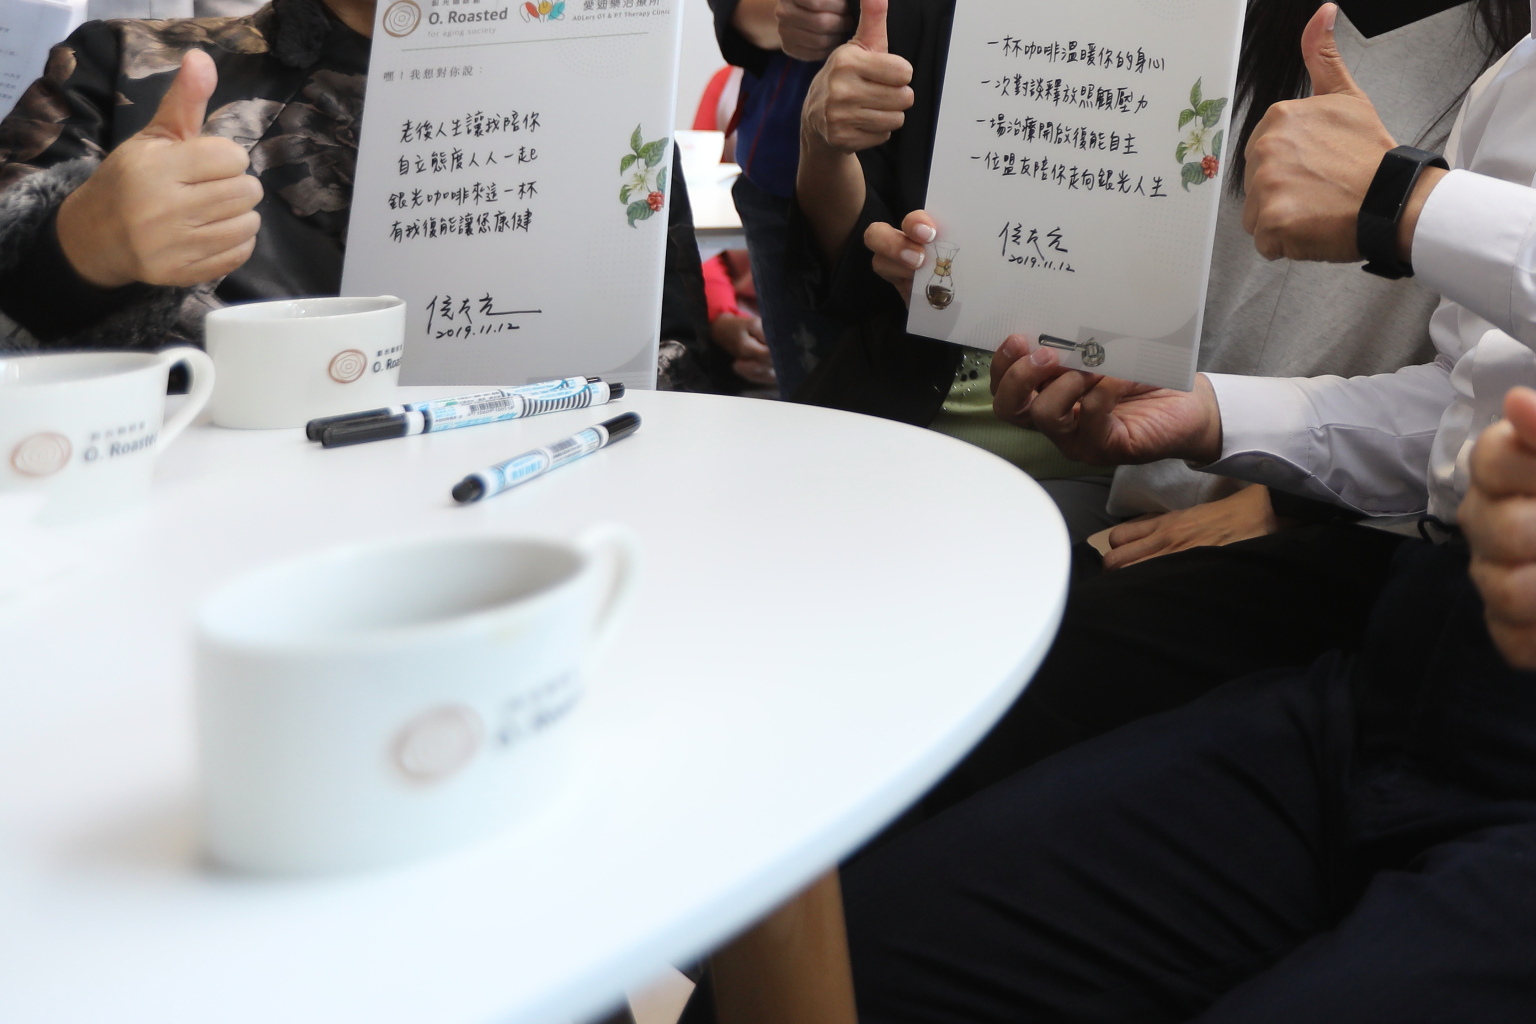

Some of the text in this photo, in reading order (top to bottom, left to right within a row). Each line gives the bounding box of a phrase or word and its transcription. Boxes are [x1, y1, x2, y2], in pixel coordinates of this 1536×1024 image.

[428, 7, 509, 26] O. Roasted
[624, 10, 651, 20] Therapy
[652, 8, 671, 17] Clinic
[442, 27, 465, 38] aging
[467, 26, 498, 36] society
[987, 34, 1165, 74] 一杯咖啡溫暖你的身心
[400, 110, 541, 144] 老後人生讓我陪你
[398, 146, 539, 176] 自立態度人人一起
[1009, 254, 1075, 273] 2019.11.12
[436, 323, 520, 339] 2019.11.12
